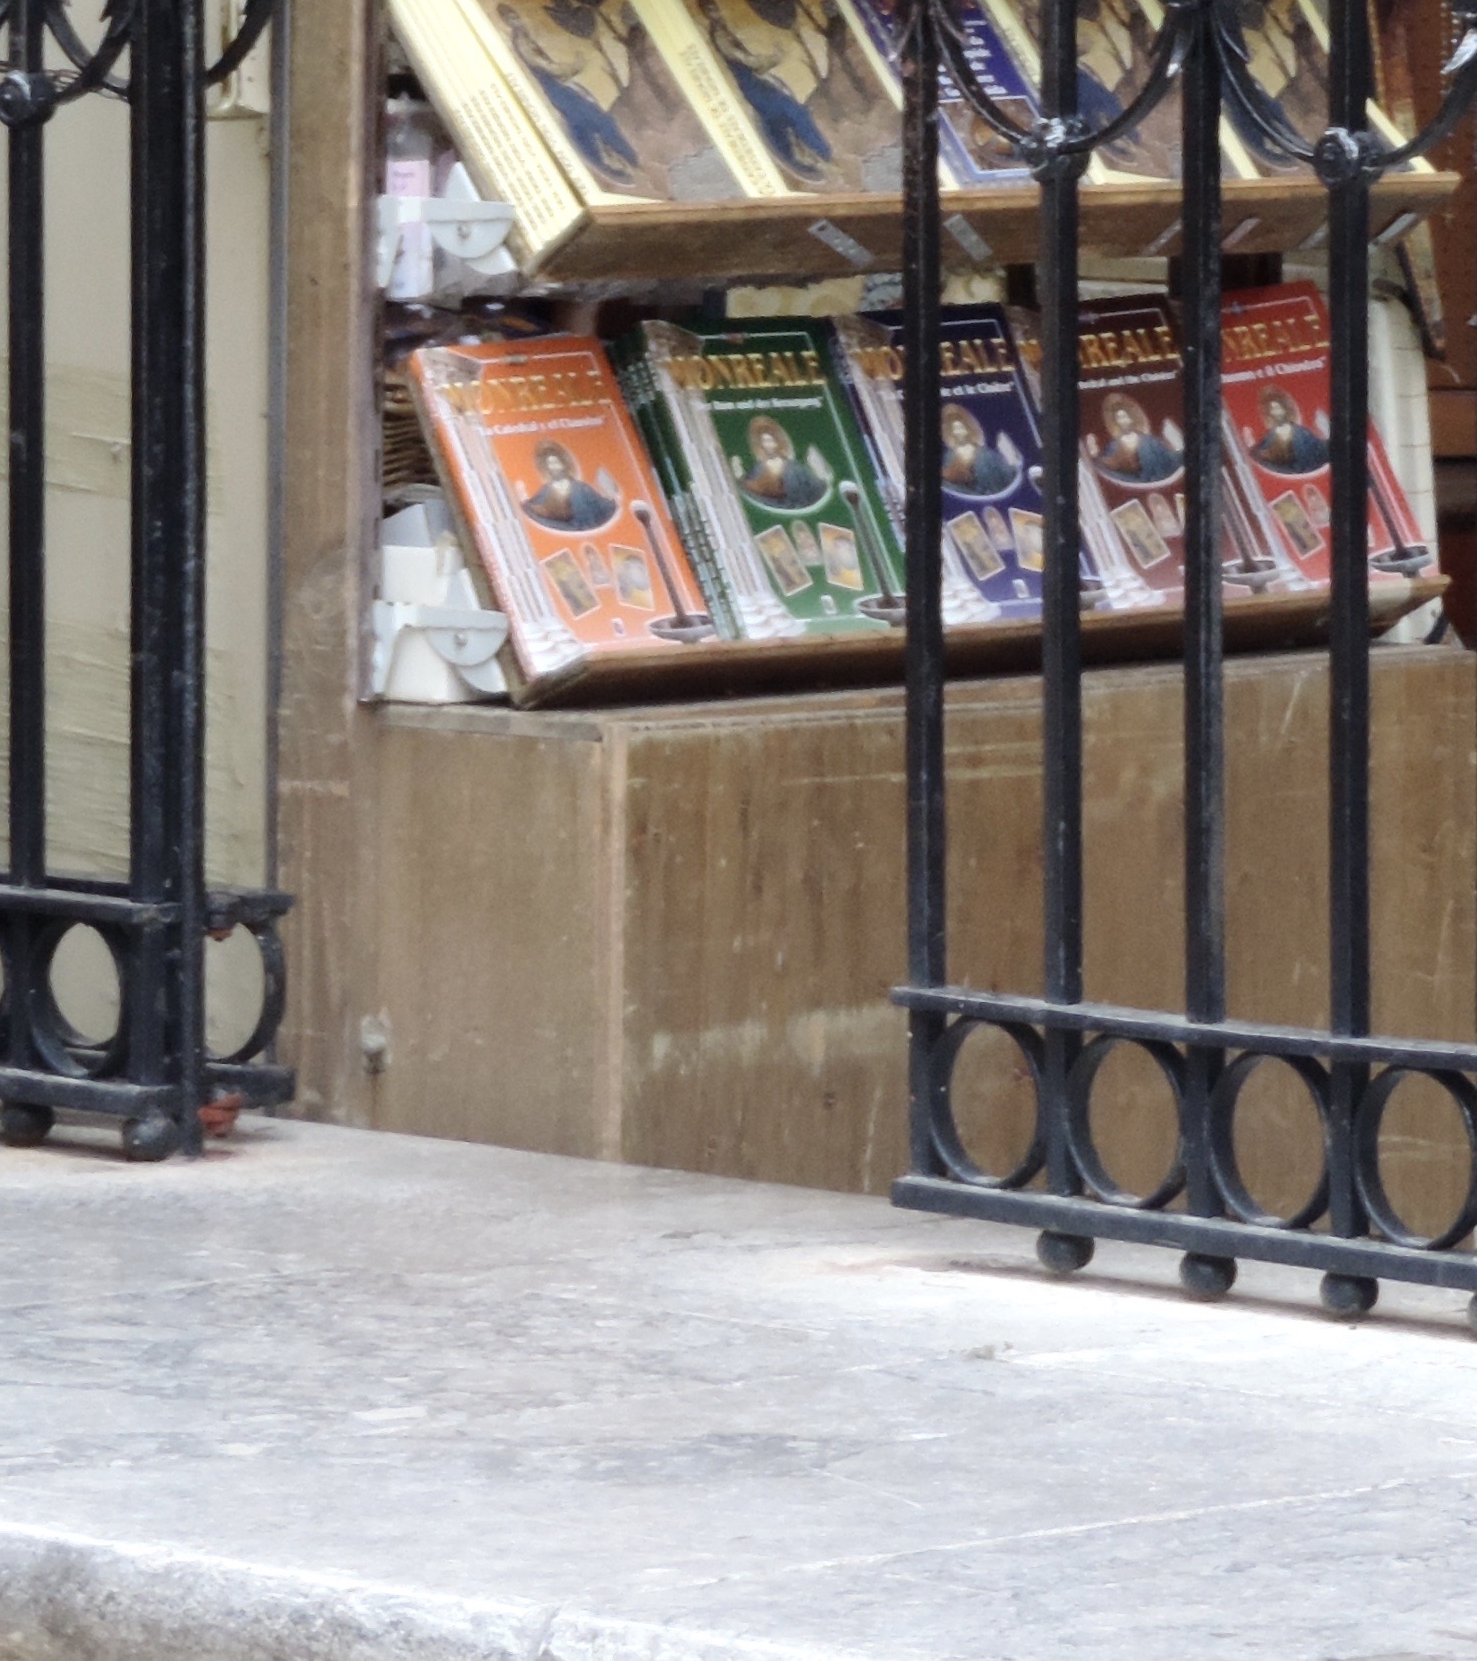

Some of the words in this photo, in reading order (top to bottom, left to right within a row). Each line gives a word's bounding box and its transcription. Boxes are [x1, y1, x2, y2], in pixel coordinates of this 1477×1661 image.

[652, 349, 828, 391] MONREALE
[848, 338, 1016, 381] MOEALE
[434, 370, 615, 417] MONREALE
